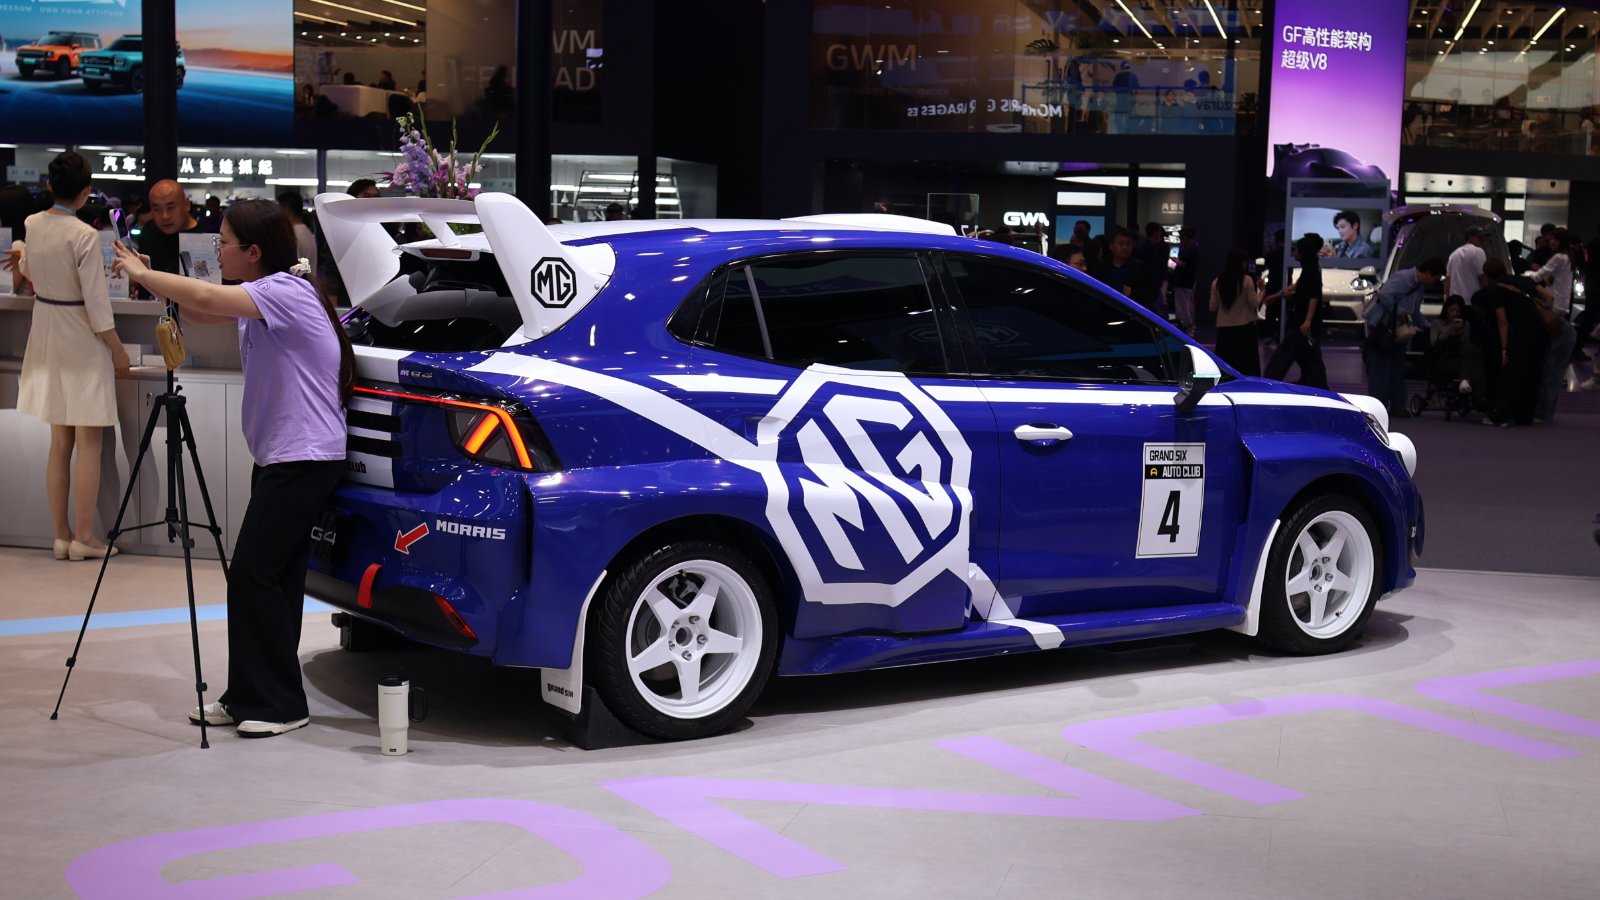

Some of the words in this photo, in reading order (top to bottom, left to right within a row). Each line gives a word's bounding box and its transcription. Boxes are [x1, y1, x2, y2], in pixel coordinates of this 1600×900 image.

[1282, 25, 1372, 51] GF高性能架构
[826, 43, 917, 71] GWM
[1281, 48, 1328, 71] 超级V8
[536, 263, 572, 302] MG
[1149, 450, 1174, 461] GRAND
[1175, 450, 1187, 461] SIX
[794, 391, 955, 573] MG
[1162, 466, 1182, 478] AUTO
[1182, 466, 1201, 478] CLUB
[435, 519, 506, 540] MORRIS
[1157, 490, 1181, 543] 4
